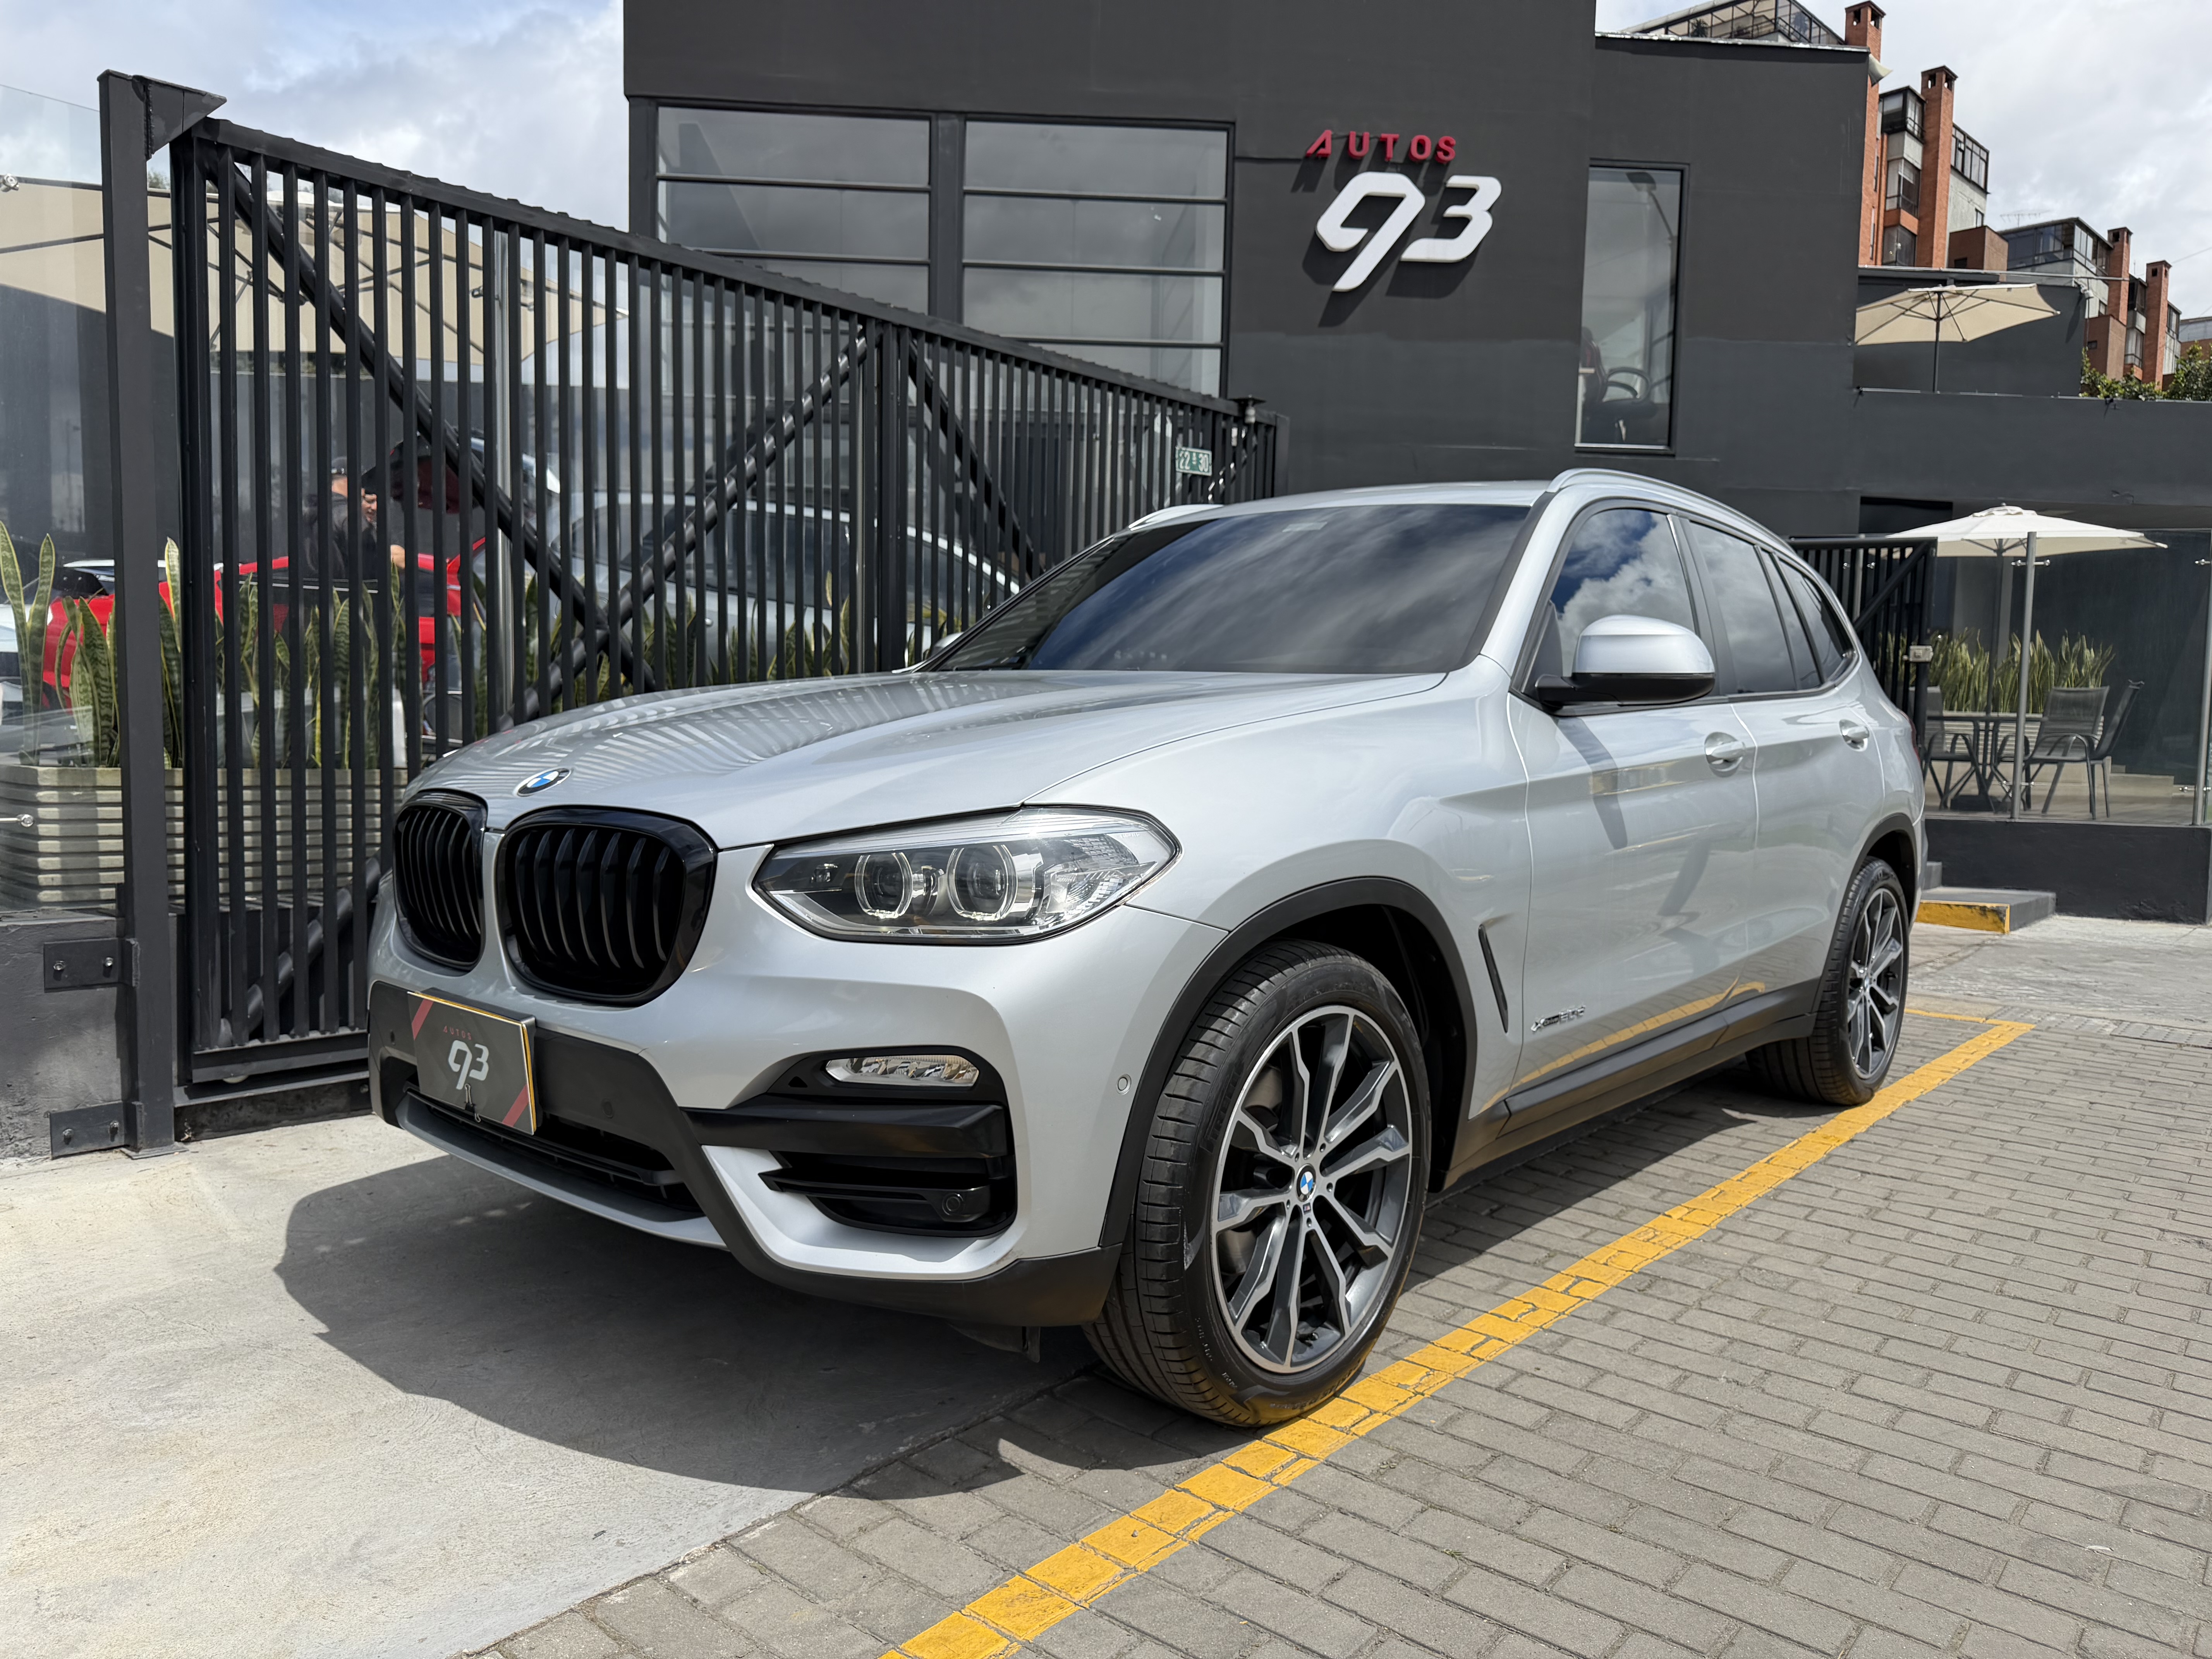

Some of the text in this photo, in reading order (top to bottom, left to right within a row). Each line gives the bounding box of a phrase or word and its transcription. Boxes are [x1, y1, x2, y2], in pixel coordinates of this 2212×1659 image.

[1306, 130, 1456, 164] AUTOS
[1316, 171, 1502, 292] 93
[1179, 450, 1190, 470] 22
[1199, 453, 1209, 472] 30
[443, 1025, 472, 1041] AUTOS
[448, 1040, 489, 1090] 93
